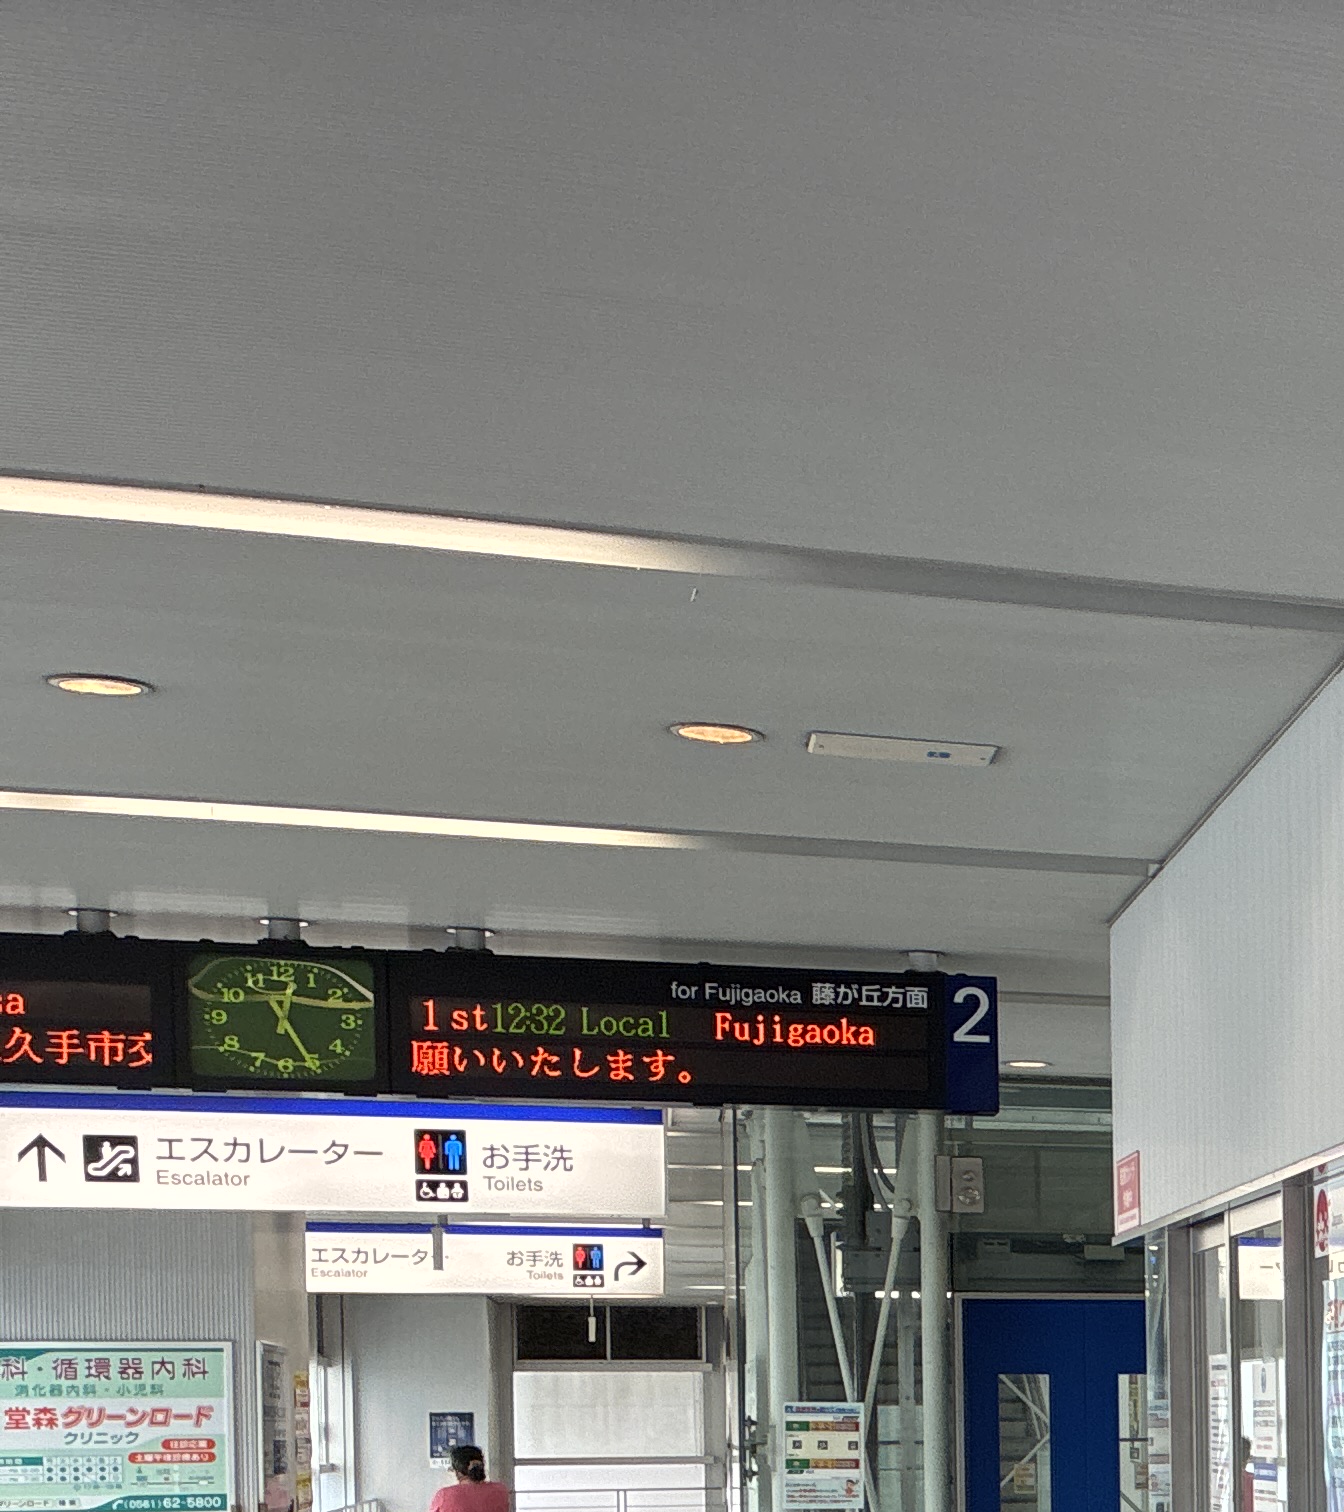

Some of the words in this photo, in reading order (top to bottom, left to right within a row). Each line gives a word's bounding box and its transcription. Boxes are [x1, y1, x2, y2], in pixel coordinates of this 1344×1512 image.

[244, 973, 264, 987] 11
[270, 966, 294, 981] 12
[307, 973, 316, 988] 1
[221, 988, 244, 1002] 10
[328, 989, 342, 1002] 2
[671, 981, 700, 999] for
[704, 982, 802, 1006] Fujigaoka
[811, 982, 929, 1009] 藤が丘方面
[211, 1010, 227, 1024] 9
[340, 1015, 356, 1029] 3
[952, 986, 991, 1044] 2
[491, 1003, 566, 1036] 12:32
[580, 1007, 671, 1038] Local
[714, 1012, 875, 1047] Fujigaoka
[224, 1035, 240, 1050] 8
[329, 1039, 344, 1053] 4
[251, 1052, 265, 1067] 7
[278, 1058, 293, 1072] 6
[305, 1053, 319, 1069] 5
[411, 1039, 692, 1084] 願いいたします。
[156, 1136, 383, 1164] エスカレーター
[481, 1143, 574, 1173] お手洗
[156, 1169, 250, 1188] Escalator
[483, 1175, 543, 1194] Toilets
[310, 1246, 449, 1266] エスカレータ
[505, 1248, 564, 1268] お手洗
[311, 1266, 368, 1279] Escalator
[526, 1269, 564, 1281] Toilets
[63, 1431, 140, 1445] クリニック
